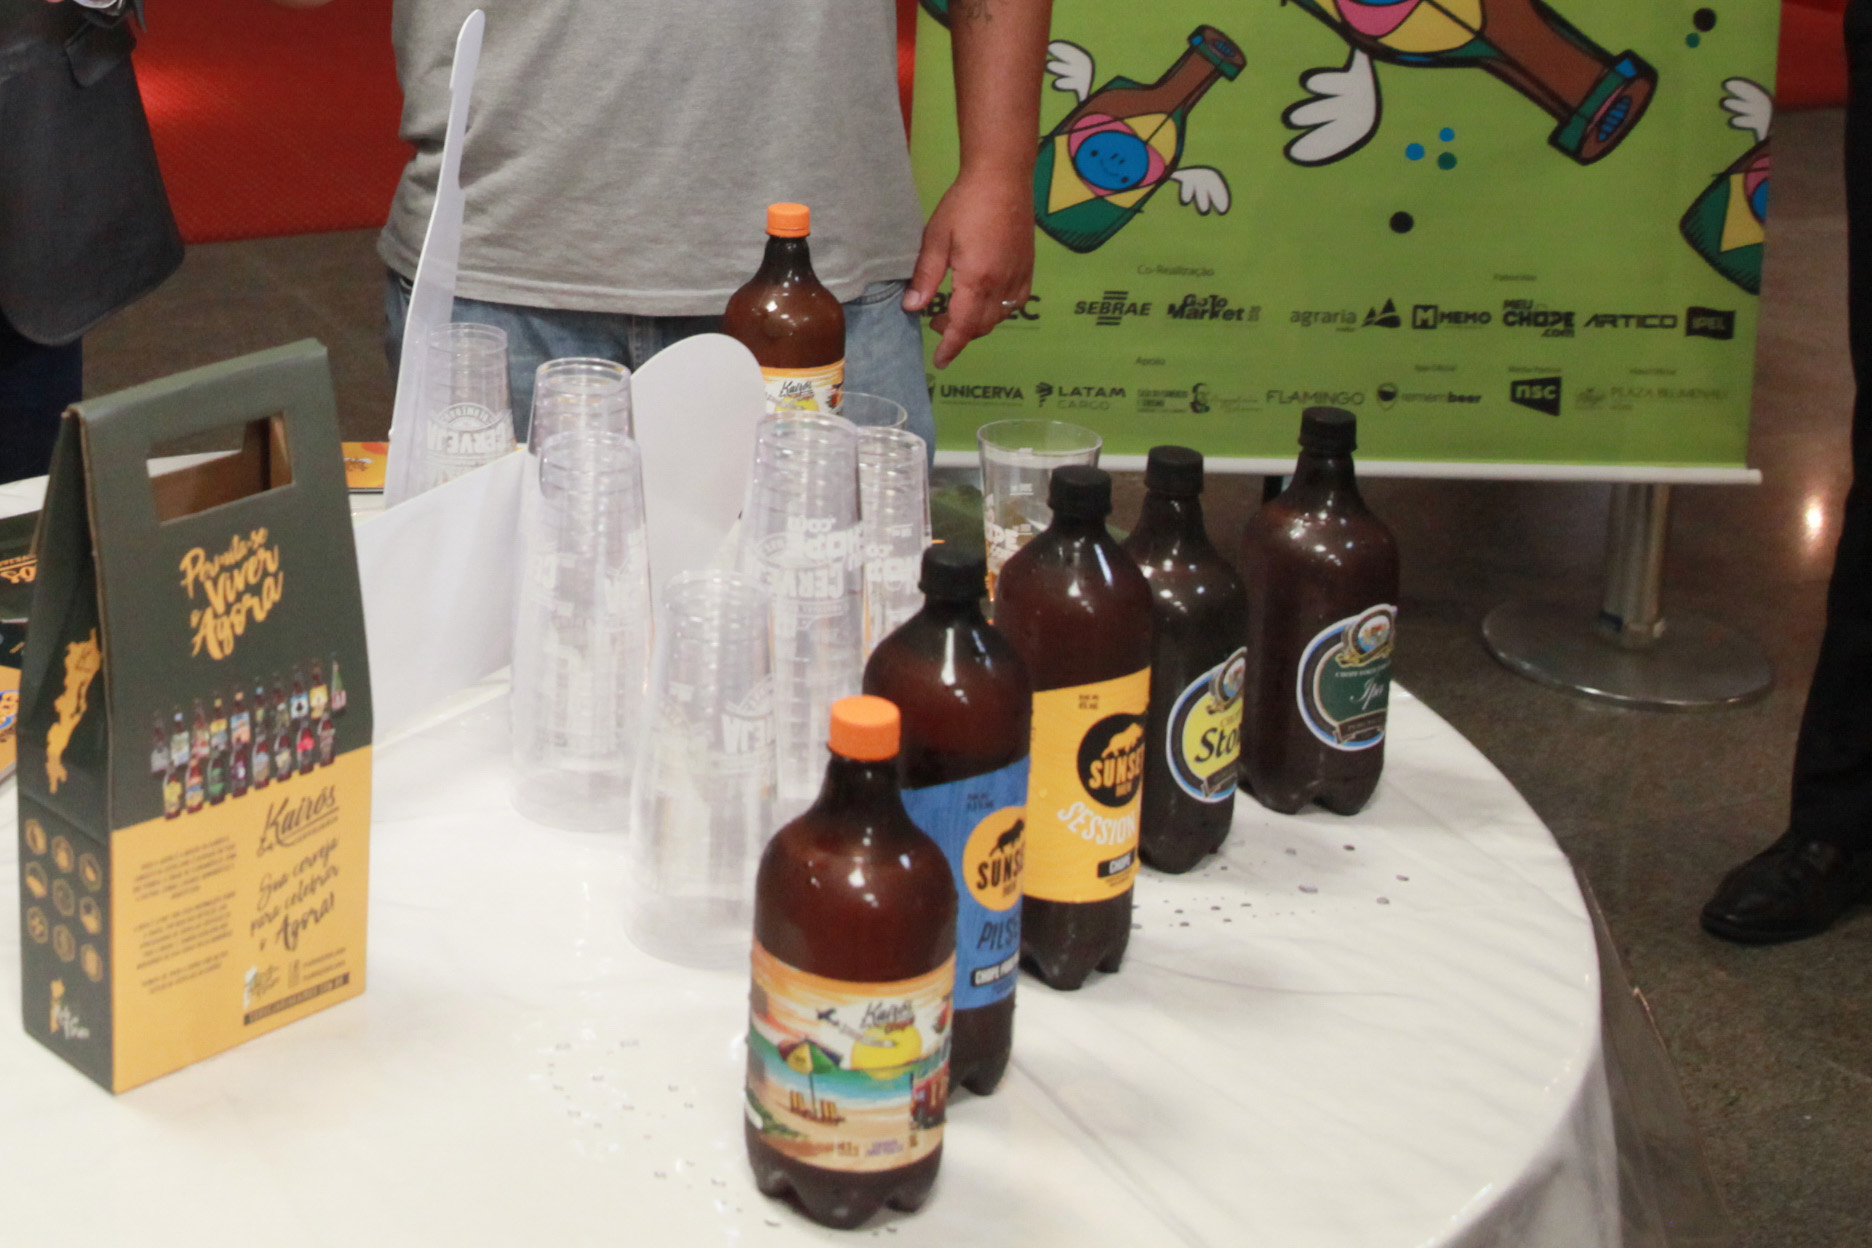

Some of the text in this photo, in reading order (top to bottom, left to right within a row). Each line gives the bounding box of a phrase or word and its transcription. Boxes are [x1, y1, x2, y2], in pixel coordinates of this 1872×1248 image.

[1074, 301, 1152, 316] SEBRAE
[1439, 310, 1492, 325] MEMO
[1502, 310, 1576, 328] CHOPE
[940, 384, 1024, 399] UNICERVA
[1058, 385, 1126, 398] LATAM
[1266, 389, 1365, 406] FLAMINGO
[1515, 384, 1558, 400] nsc
[976, 917, 1017, 950] PILS
